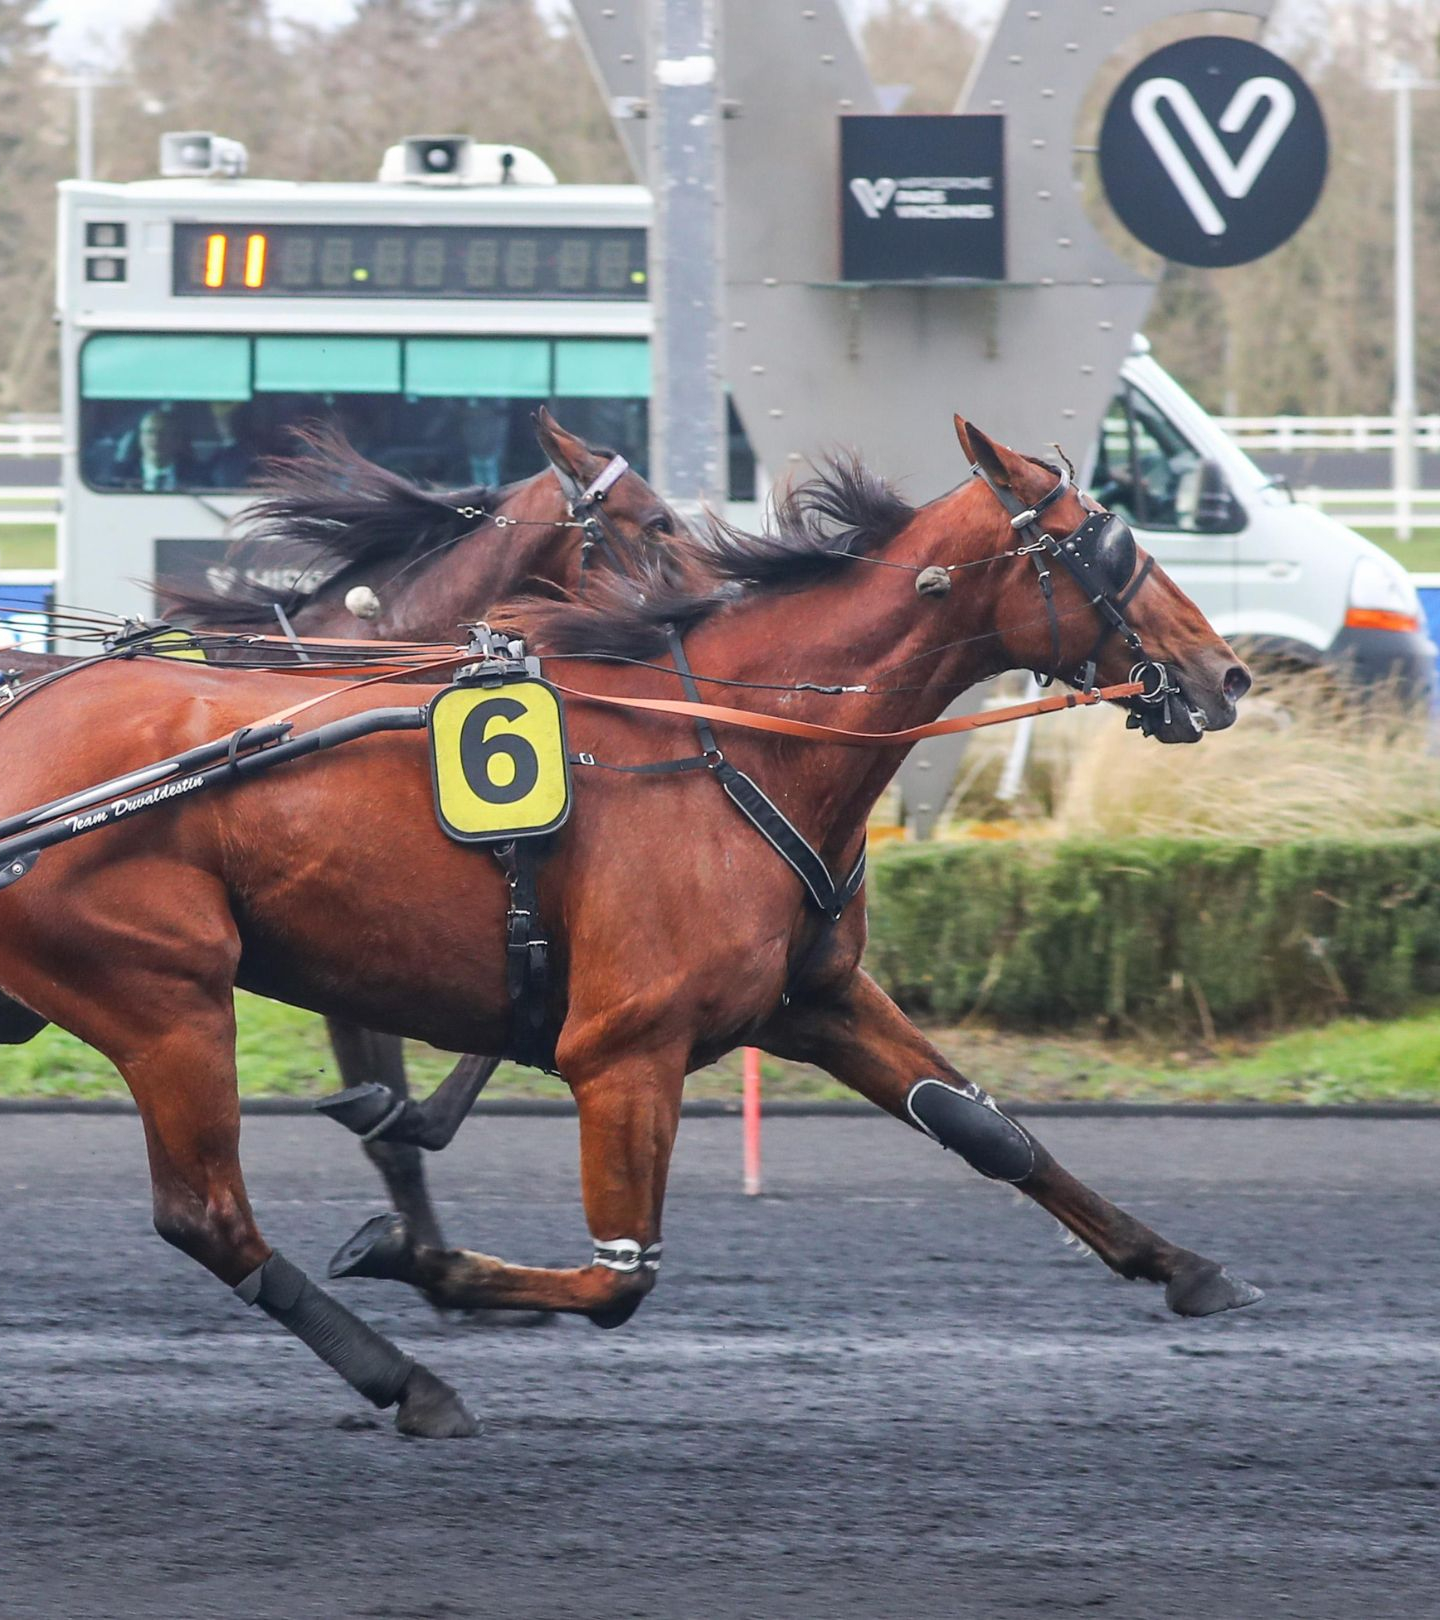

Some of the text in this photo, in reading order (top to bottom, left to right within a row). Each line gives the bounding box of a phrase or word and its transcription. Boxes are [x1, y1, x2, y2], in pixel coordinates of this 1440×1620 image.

[205, 234, 266, 288] 11
[460, 697, 539, 804] 6
[64, 776, 204, 832] Team Duvaldestin
